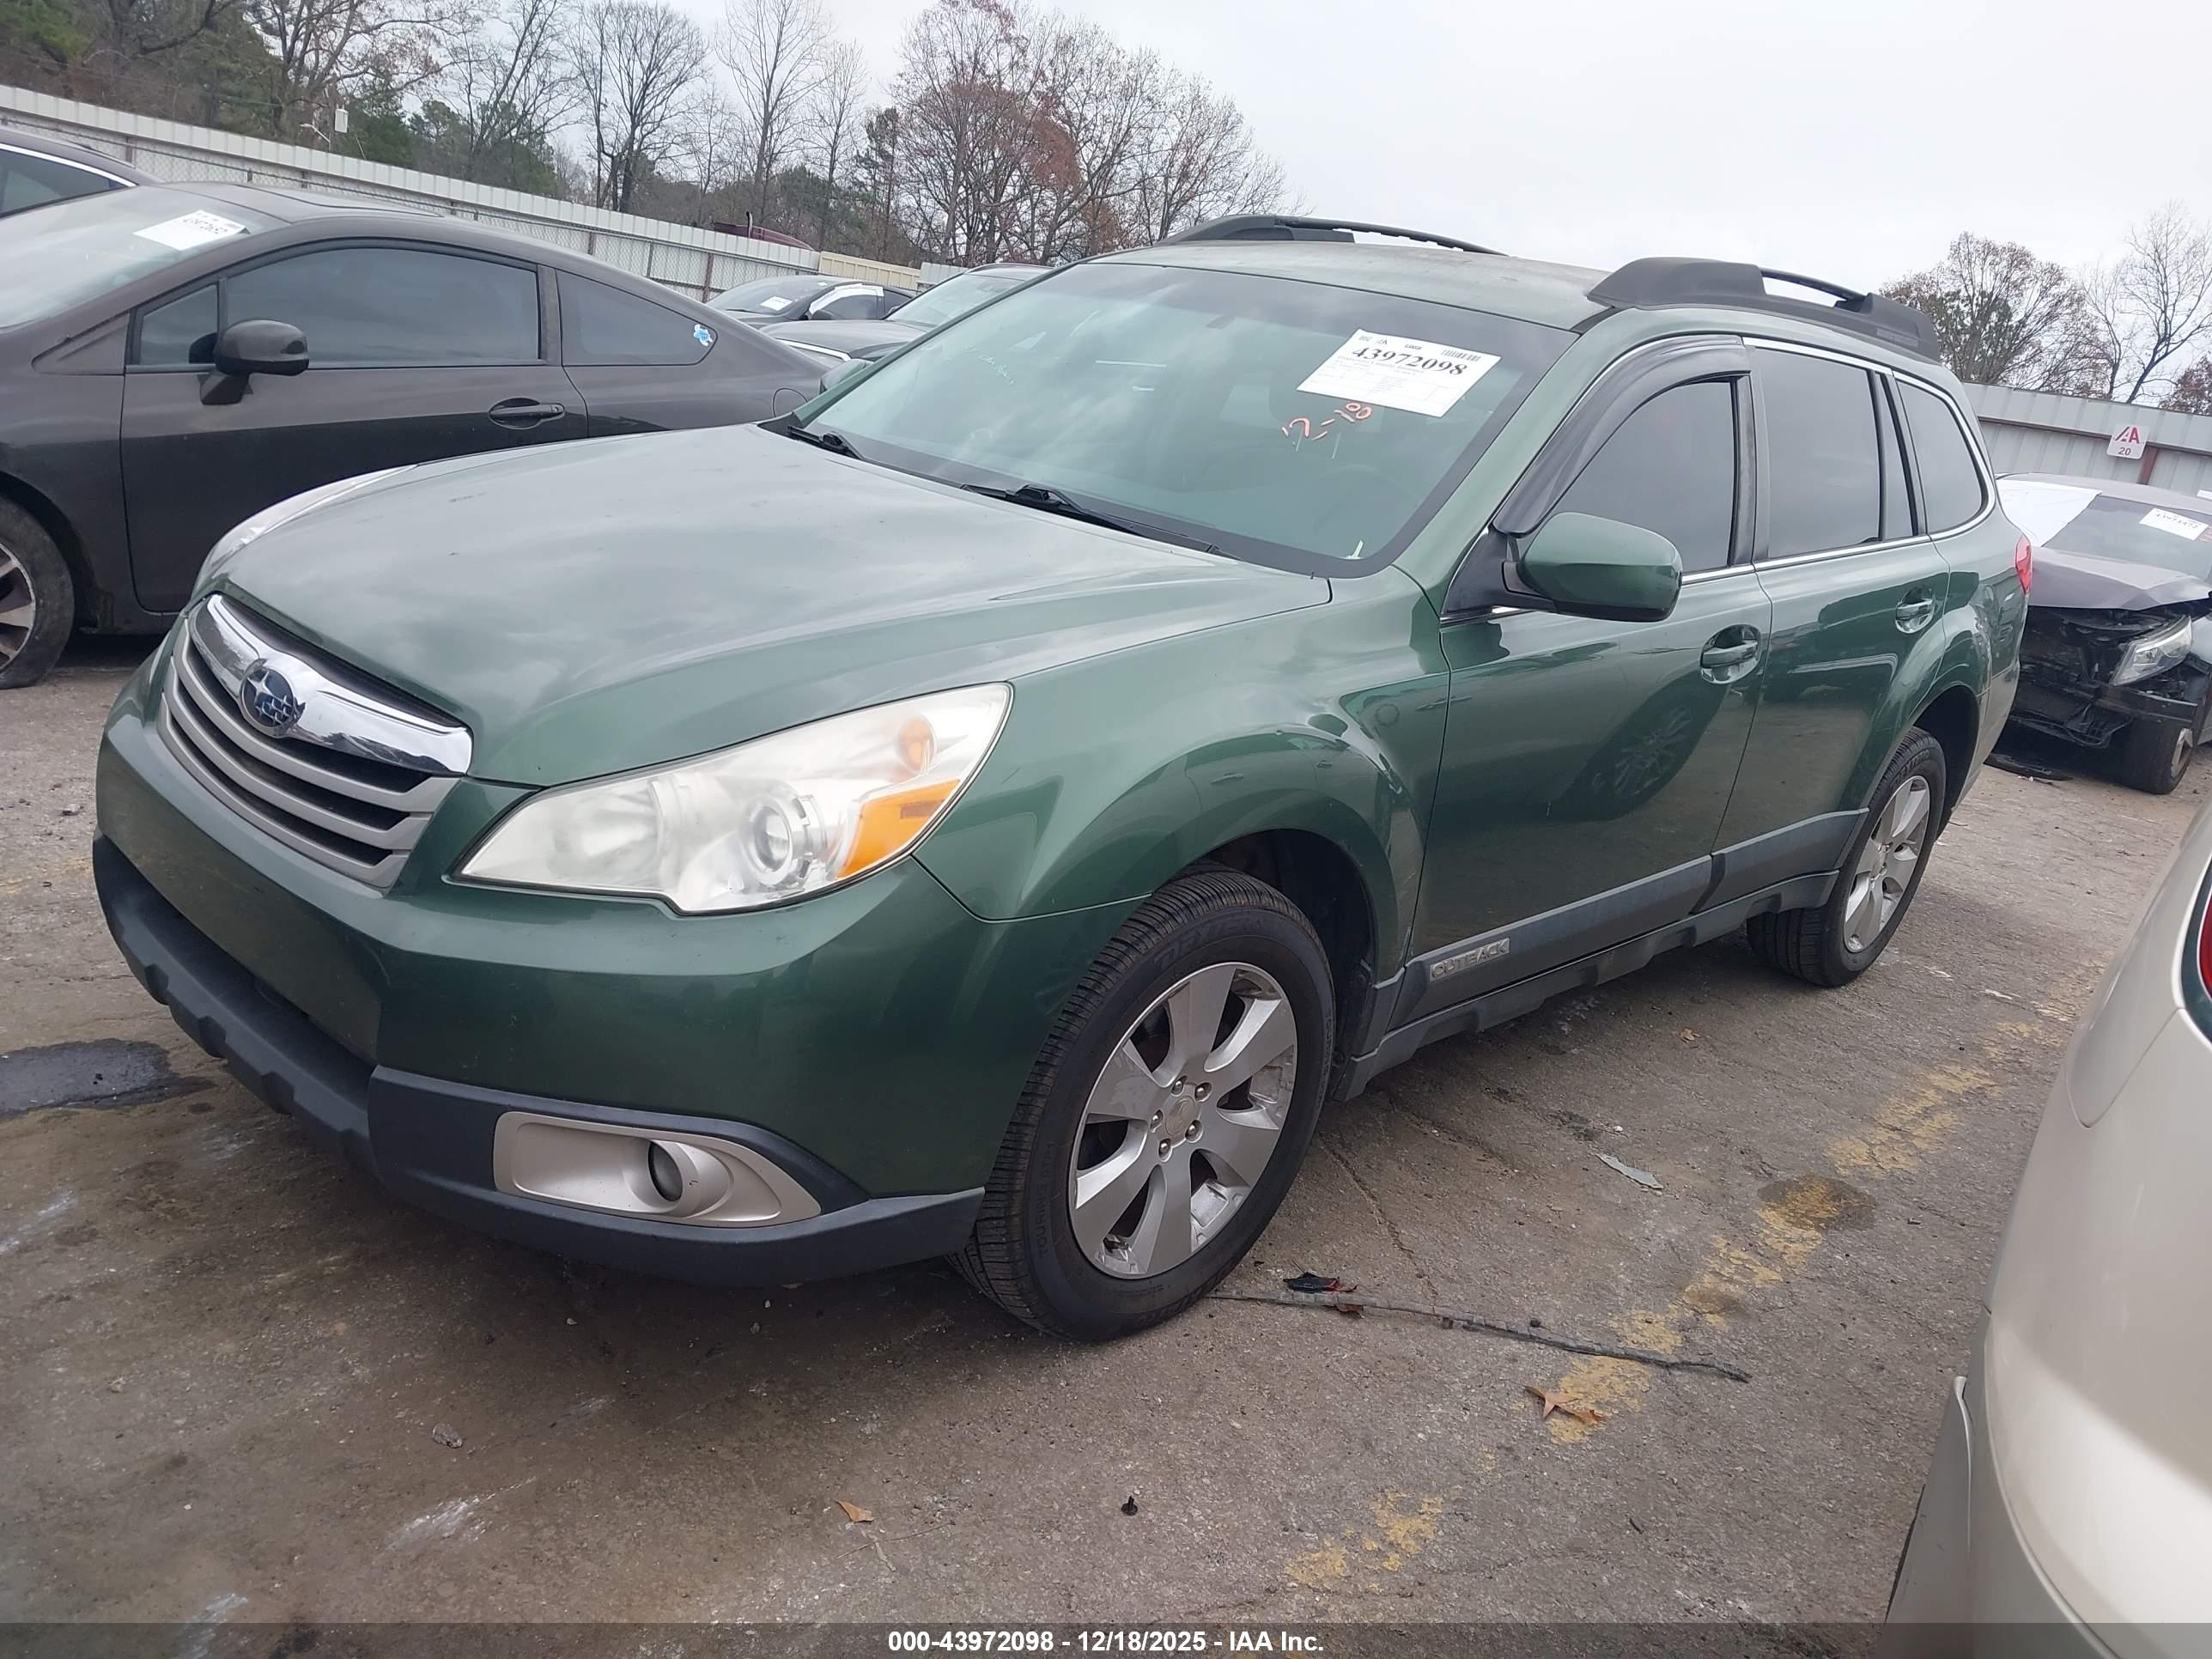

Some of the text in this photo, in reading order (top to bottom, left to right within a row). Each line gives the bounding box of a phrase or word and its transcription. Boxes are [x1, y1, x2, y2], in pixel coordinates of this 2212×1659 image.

[1352, 346, 1468, 375] 43972098
[2118, 447, 2131, 456] 20
[1431, 937, 1510, 979] OUTBACK
